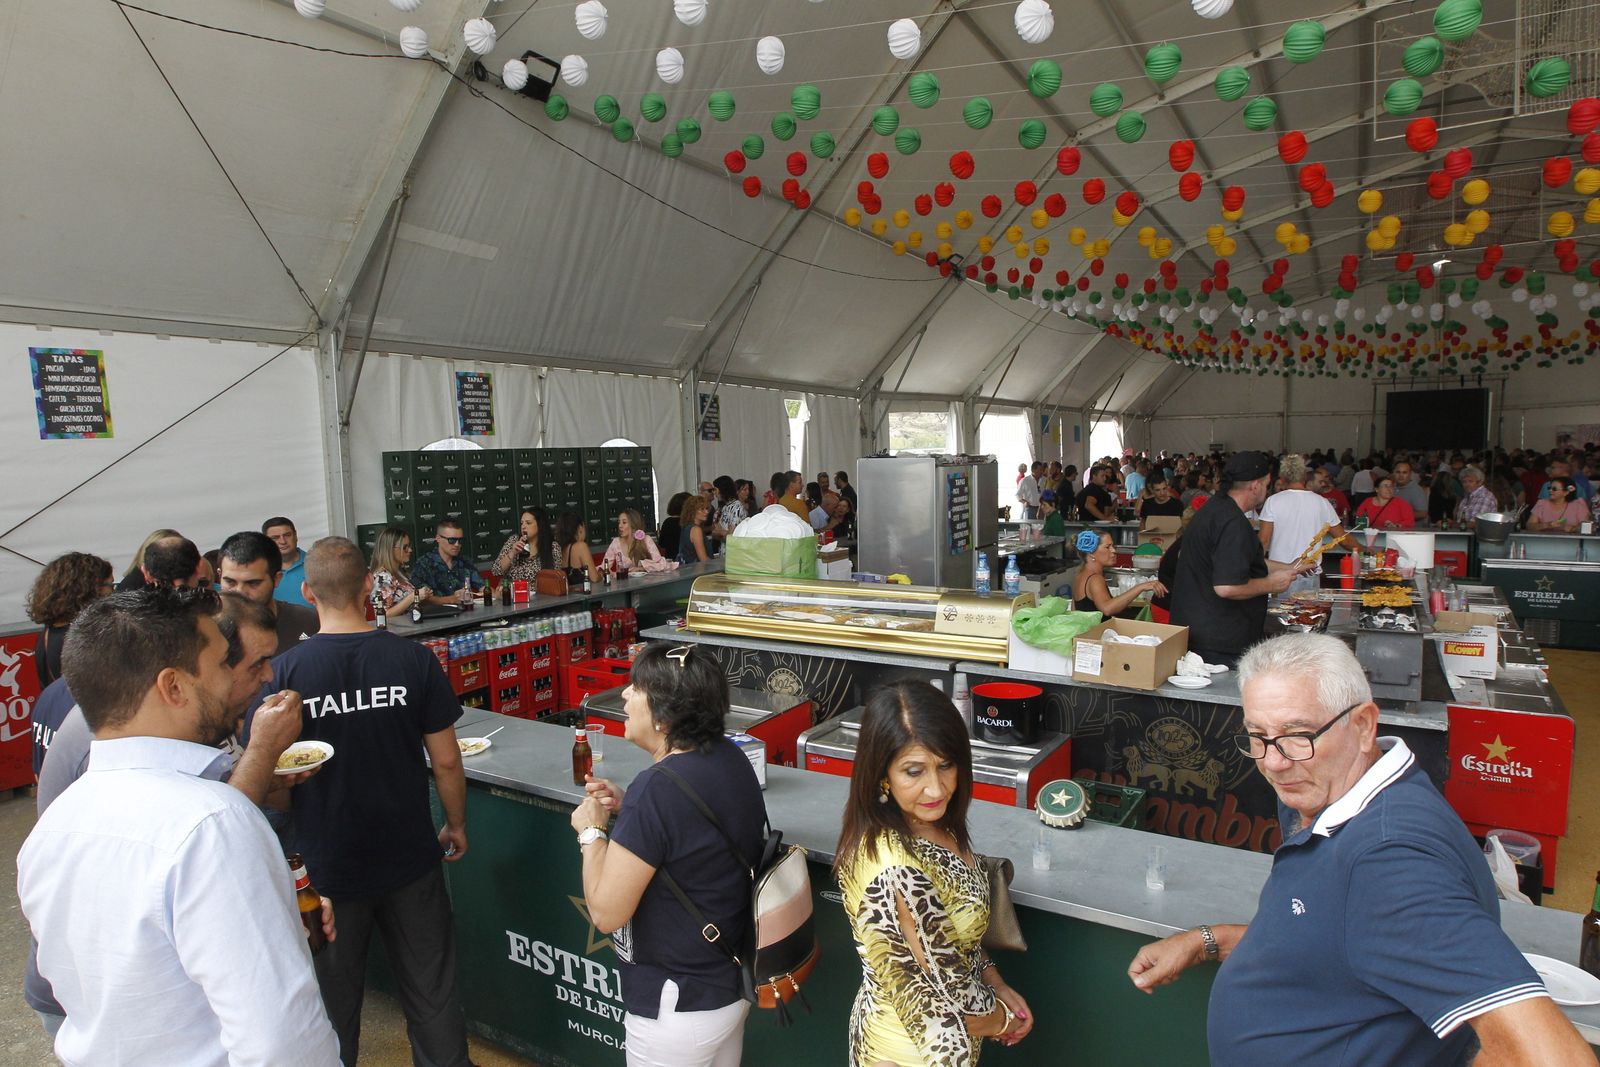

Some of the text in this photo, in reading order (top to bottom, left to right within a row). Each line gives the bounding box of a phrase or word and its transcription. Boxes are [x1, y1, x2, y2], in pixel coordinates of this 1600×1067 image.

[52, 355, 84, 363] TAPAS
[1514, 590, 1576, 601] ESTRELLA
[303, 685, 408, 719] TALLER
[977, 714, 1014, 728] BACARDI
[1461, 753, 1533, 778] Estrella
[555, 983, 625, 1025] DE LEV
